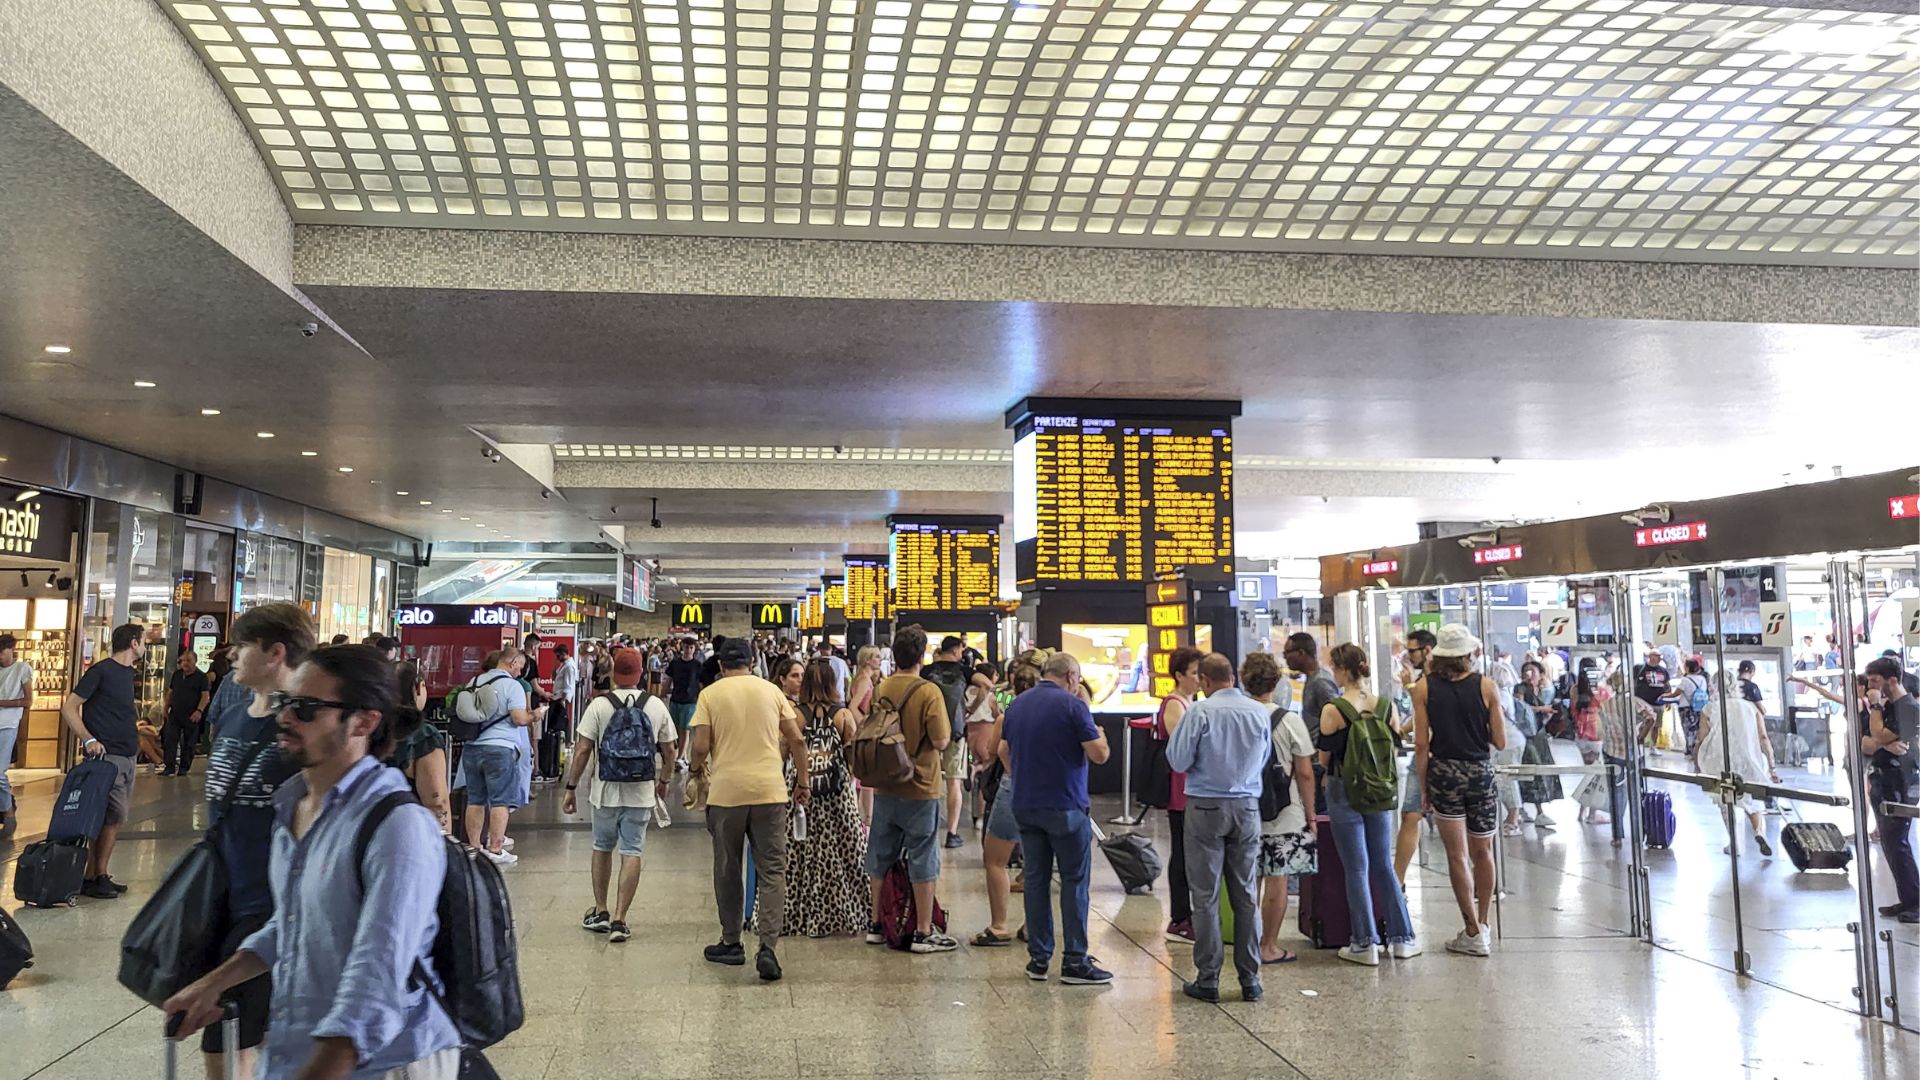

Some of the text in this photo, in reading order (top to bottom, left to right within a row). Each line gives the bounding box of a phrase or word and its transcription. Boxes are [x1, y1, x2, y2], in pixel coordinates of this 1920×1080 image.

[1034, 417, 1078, 427] PARTENZE
[1651, 524, 1690, 544] CLOSED
[1484, 547, 1511, 562] CLOSED
[201, 621, 213, 629] 20
[810, 772, 833, 791] ITY
